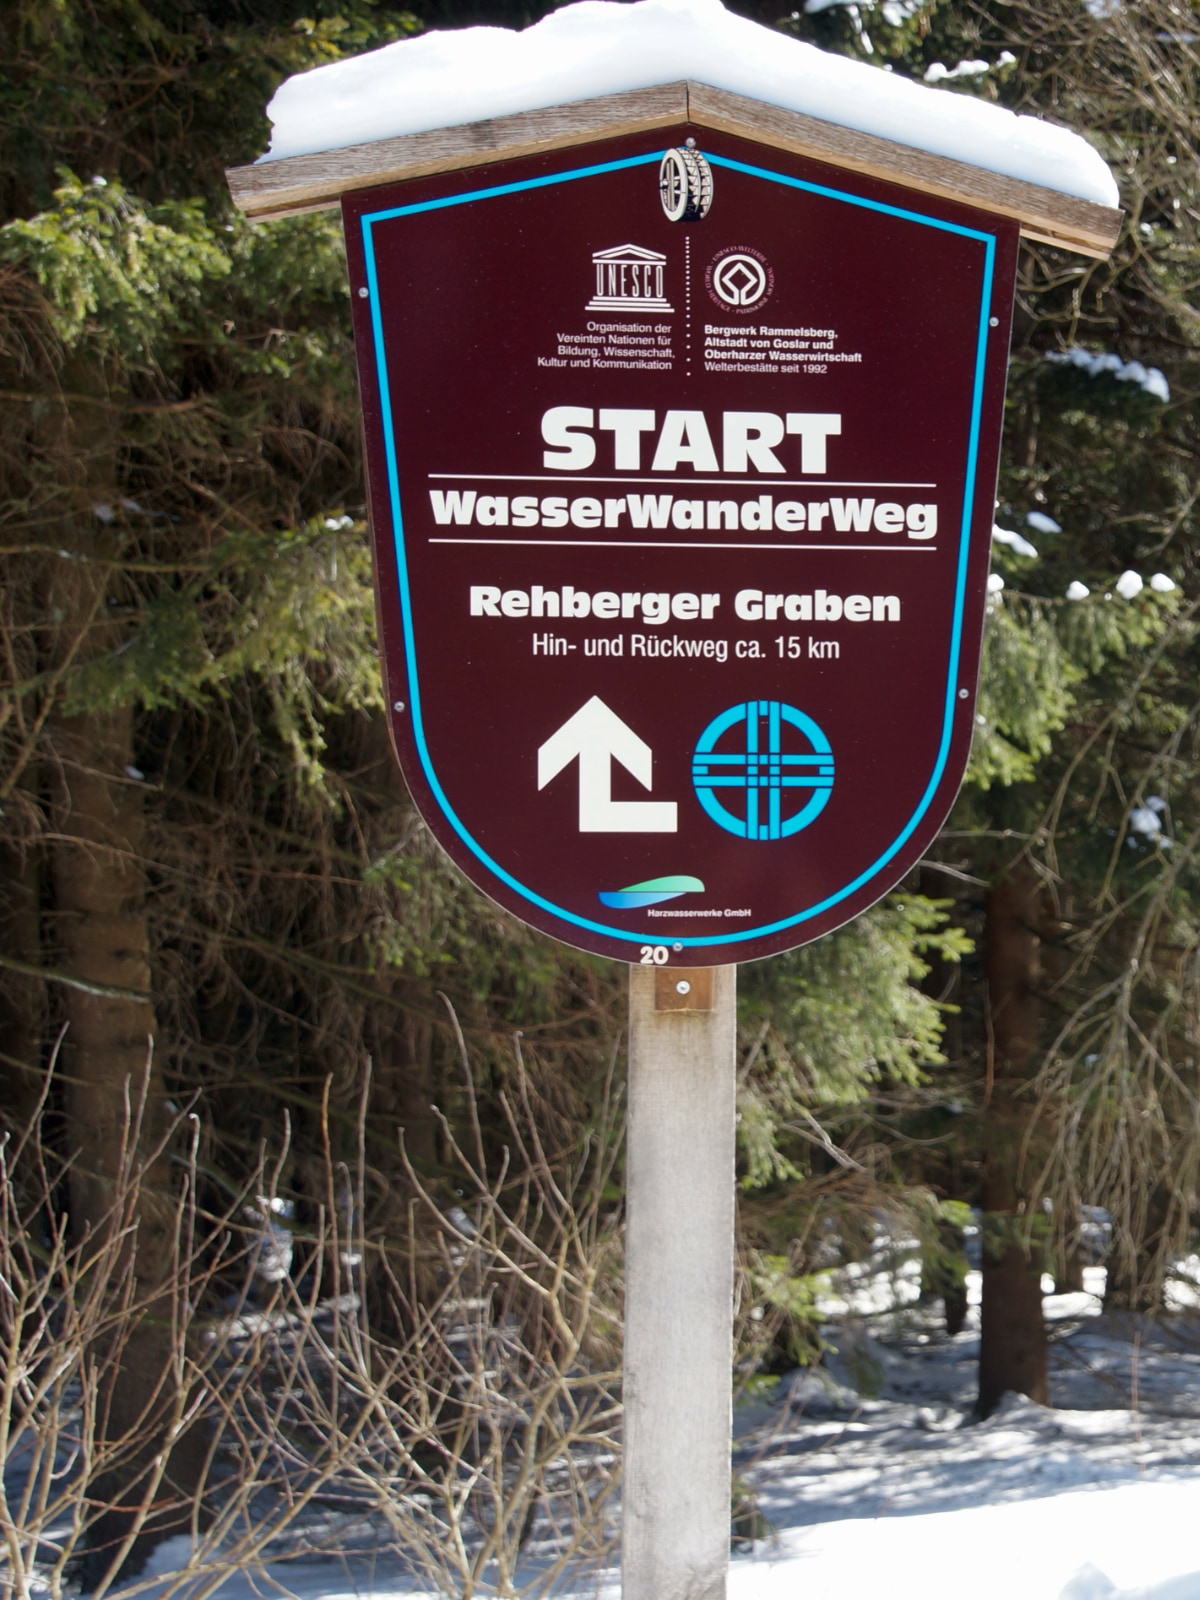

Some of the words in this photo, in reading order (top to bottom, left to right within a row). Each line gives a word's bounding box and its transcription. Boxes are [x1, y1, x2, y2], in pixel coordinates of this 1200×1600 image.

[597, 264, 664, 298] UNESCO
[587, 321, 652, 334] Organisation
[654, 324, 672, 333] der
[704, 325, 757, 337] Bergwerk
[759, 326, 838, 339] Rammelsberg,
[557, 333, 606, 344] Vereinten
[608, 334, 655, 345] Nationen
[657, 336, 672, 345] für
[704, 337, 747, 348] Altstadt
[750, 340, 770, 348] von
[773, 339, 810, 349] Goslar
[812, 340, 834, 350] und
[558, 345, 601, 358] Bildung,
[603, 346, 675, 359] Wissenschaft,
[704, 349, 766, 360] Oberharzer
[769, 351, 862, 362] Wasserwirtschaft
[537, 357, 568, 367] Kultur
[570, 358, 590, 368] und
[593, 359, 672, 370] Kommunikation
[704, 361, 779, 373] Welterbestätte
[781, 363, 800, 373] seit
[802, 364, 828, 374] 1992
[540, 406, 842, 474] START
[429, 490, 938, 540] WasserWanderWeg
[470, 586, 720, 625] Rehberger
[735, 589, 901, 622] Graben
[532, 633, 577, 656] Hin-
[584, 633, 624, 657] und
[631, 633, 728, 663] Rückweg
[735, 640, 767, 659] ca.
[774, 636, 801, 659] 15
[808, 636, 840, 659] km
[647, 909, 723, 918] Harzwasserwerke
[724, 909, 752, 917] GmbH
[640, 945, 669, 965] 20
